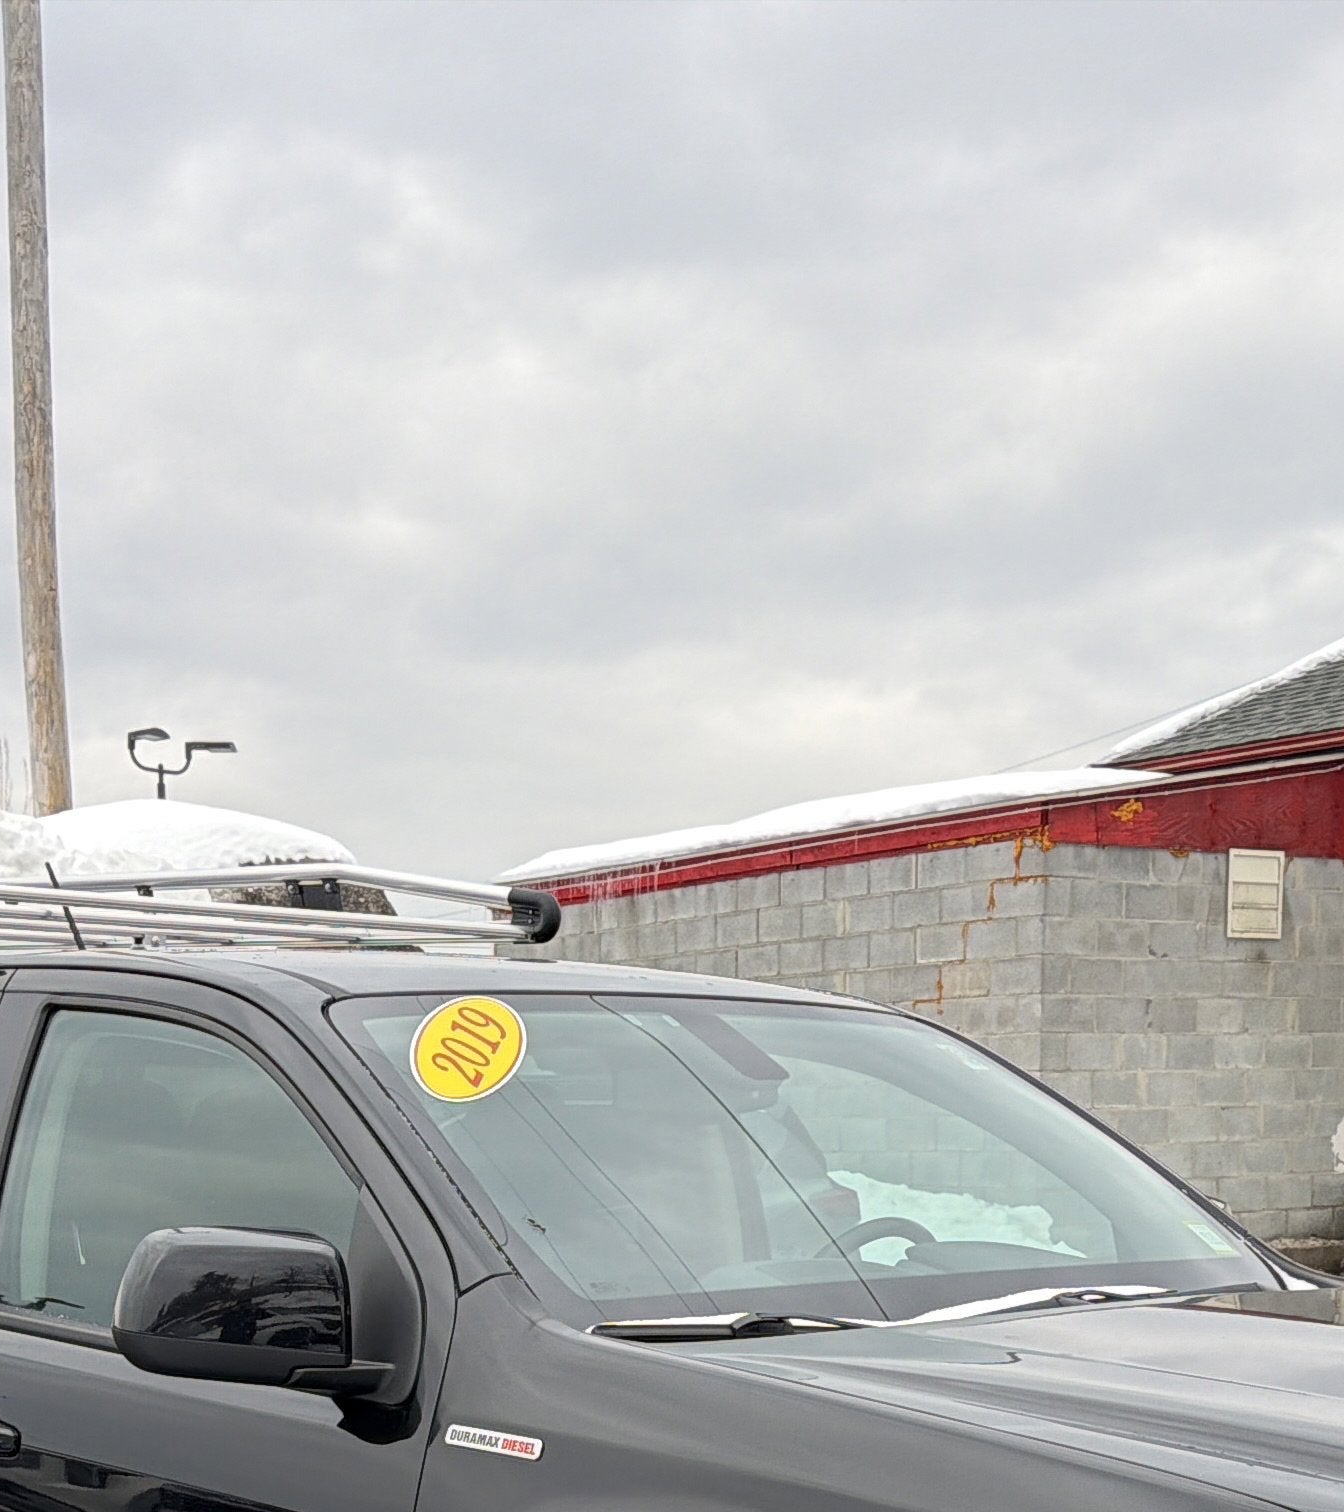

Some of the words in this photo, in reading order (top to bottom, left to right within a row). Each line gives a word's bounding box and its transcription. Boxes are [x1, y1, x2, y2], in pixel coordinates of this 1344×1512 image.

[432, 1006, 506, 1088] 2019
[449, 1429, 499, 1448] DURAMAX
[501, 1438, 535, 1455] DIESEL
